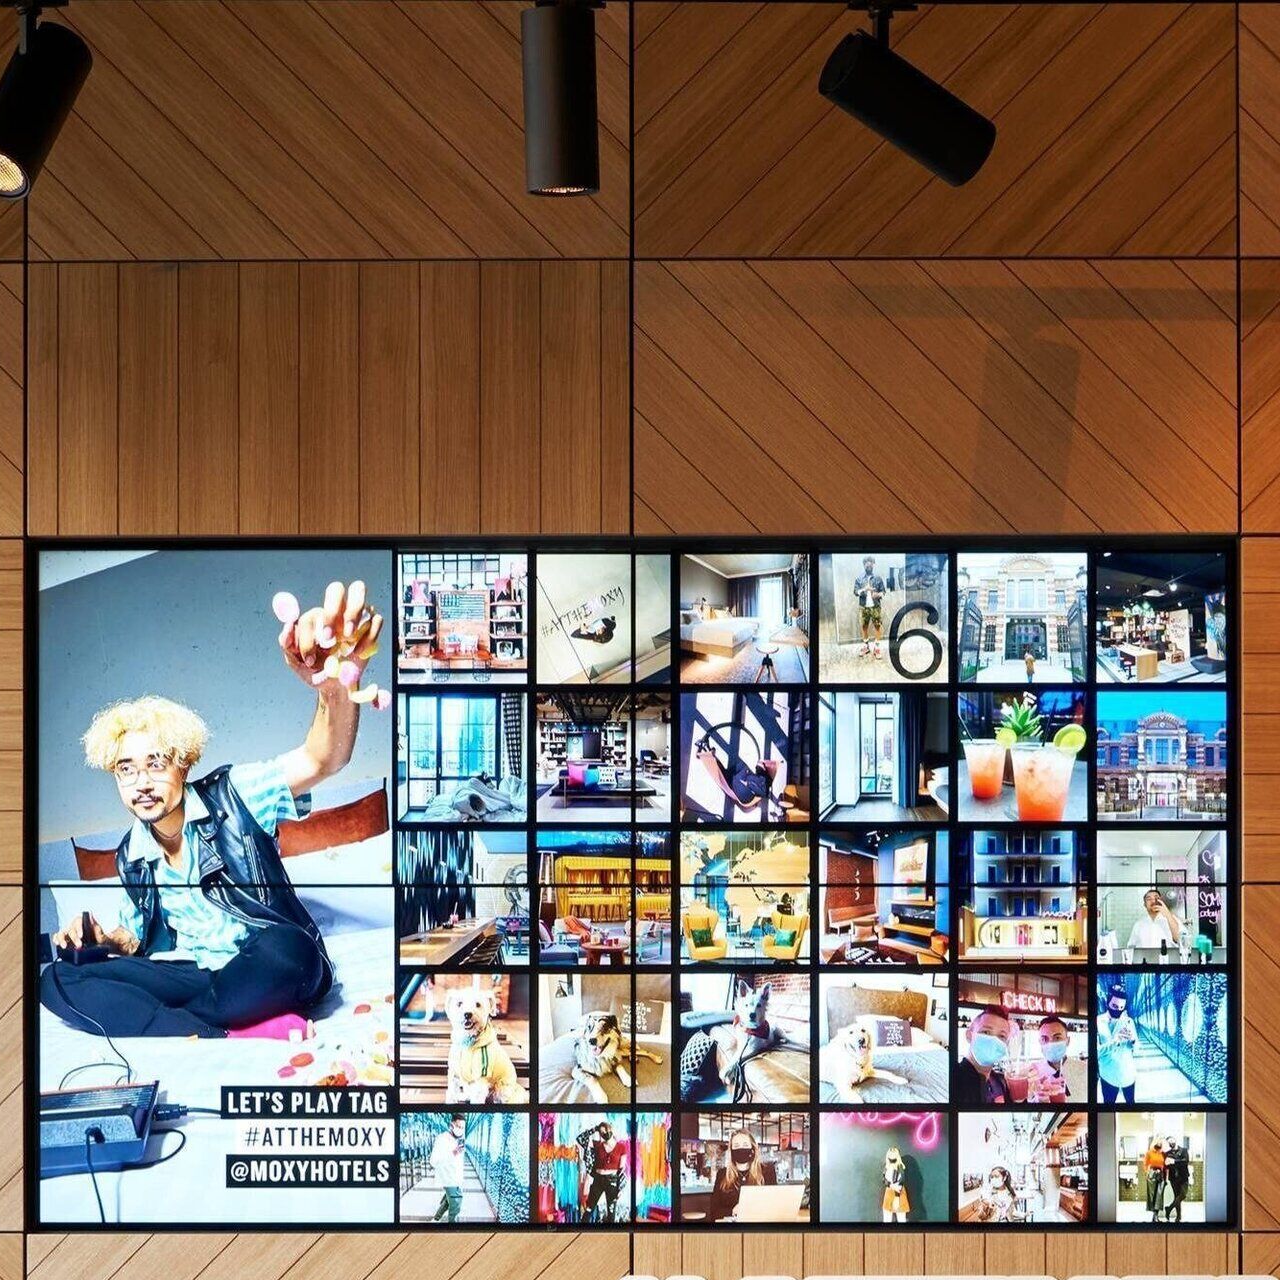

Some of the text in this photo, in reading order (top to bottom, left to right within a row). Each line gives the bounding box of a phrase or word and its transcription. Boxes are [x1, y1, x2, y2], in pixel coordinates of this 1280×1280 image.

[889, 601, 943, 680] 6
[1003, 991, 1056, 1014] CHECK IN
[227, 1091, 388, 1114] LET’S PLAY TAG
[244, 1126, 387, 1147] #ATTHEMOXY
[230, 1160, 390, 1183] @MOXYHOTELS
